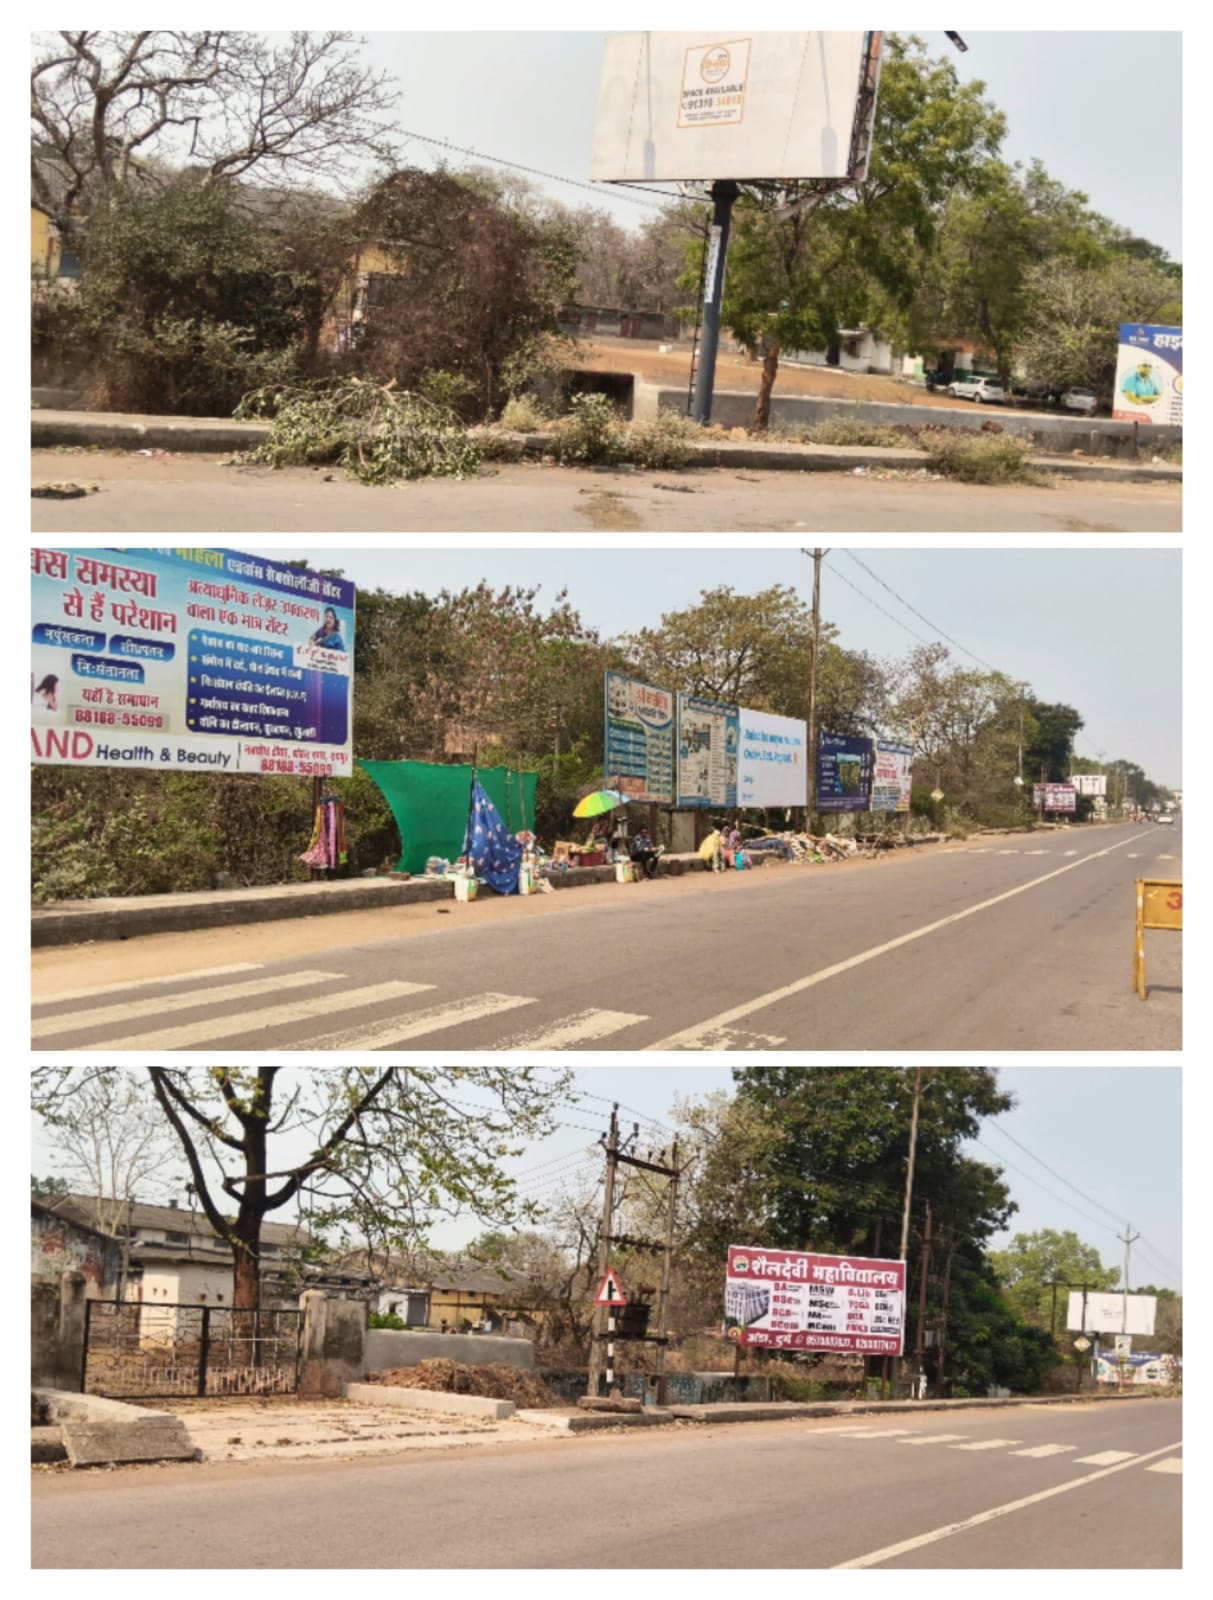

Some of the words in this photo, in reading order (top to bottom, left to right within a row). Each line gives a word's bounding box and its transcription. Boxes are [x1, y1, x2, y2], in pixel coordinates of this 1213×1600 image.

[705, 83, 743, 96] AVAILABLE
[75, 556, 158, 597] समस्या
[62, 586, 83, 618] से
[90, 591, 106, 623] हैं
[110, 598, 177, 634] परेशान
[187, 579, 249, 605] अत्याधुनिक
[280, 599, 320, 622] उपकरण
[186, 601, 215, 621] वाला
[218, 608, 238, 626] एक
[241, 614, 262, 631] मात्र
[44, 627, 95, 647] नपुंसकता
[118, 692, 159, 709] समाधान
[96, 744, 154, 760] Health
[160, 747, 171, 762] &
[177, 747, 231, 768] Beauty
[751, 1255, 808, 1280] शैलदेवी
[812, 1263, 898, 1286] महाविद्यालय
